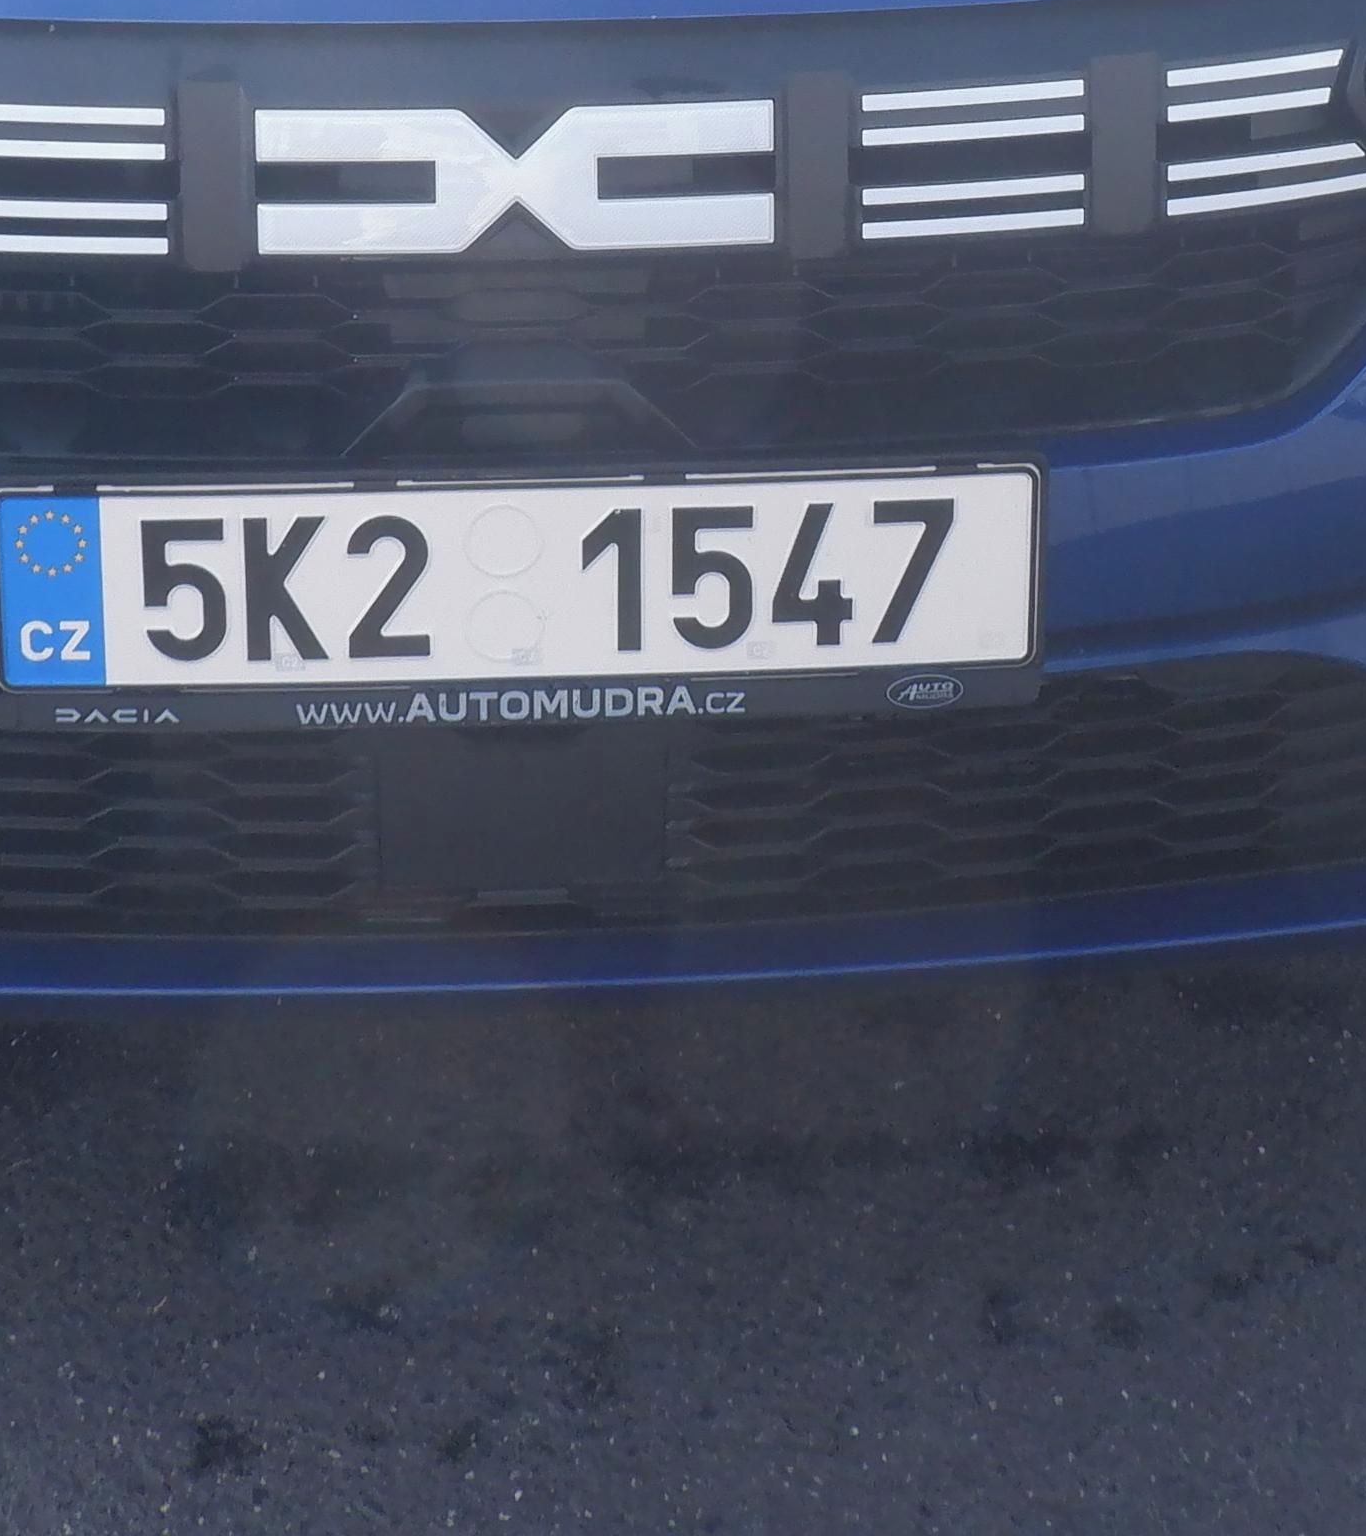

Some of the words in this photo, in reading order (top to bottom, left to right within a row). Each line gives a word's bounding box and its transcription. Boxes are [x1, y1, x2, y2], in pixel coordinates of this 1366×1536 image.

[139, 514, 432, 662] 5K2
[580, 497, 956, 653] 1547
[19, 619, 92, 662] CZ
[54, 707, 181, 725] DACIA
